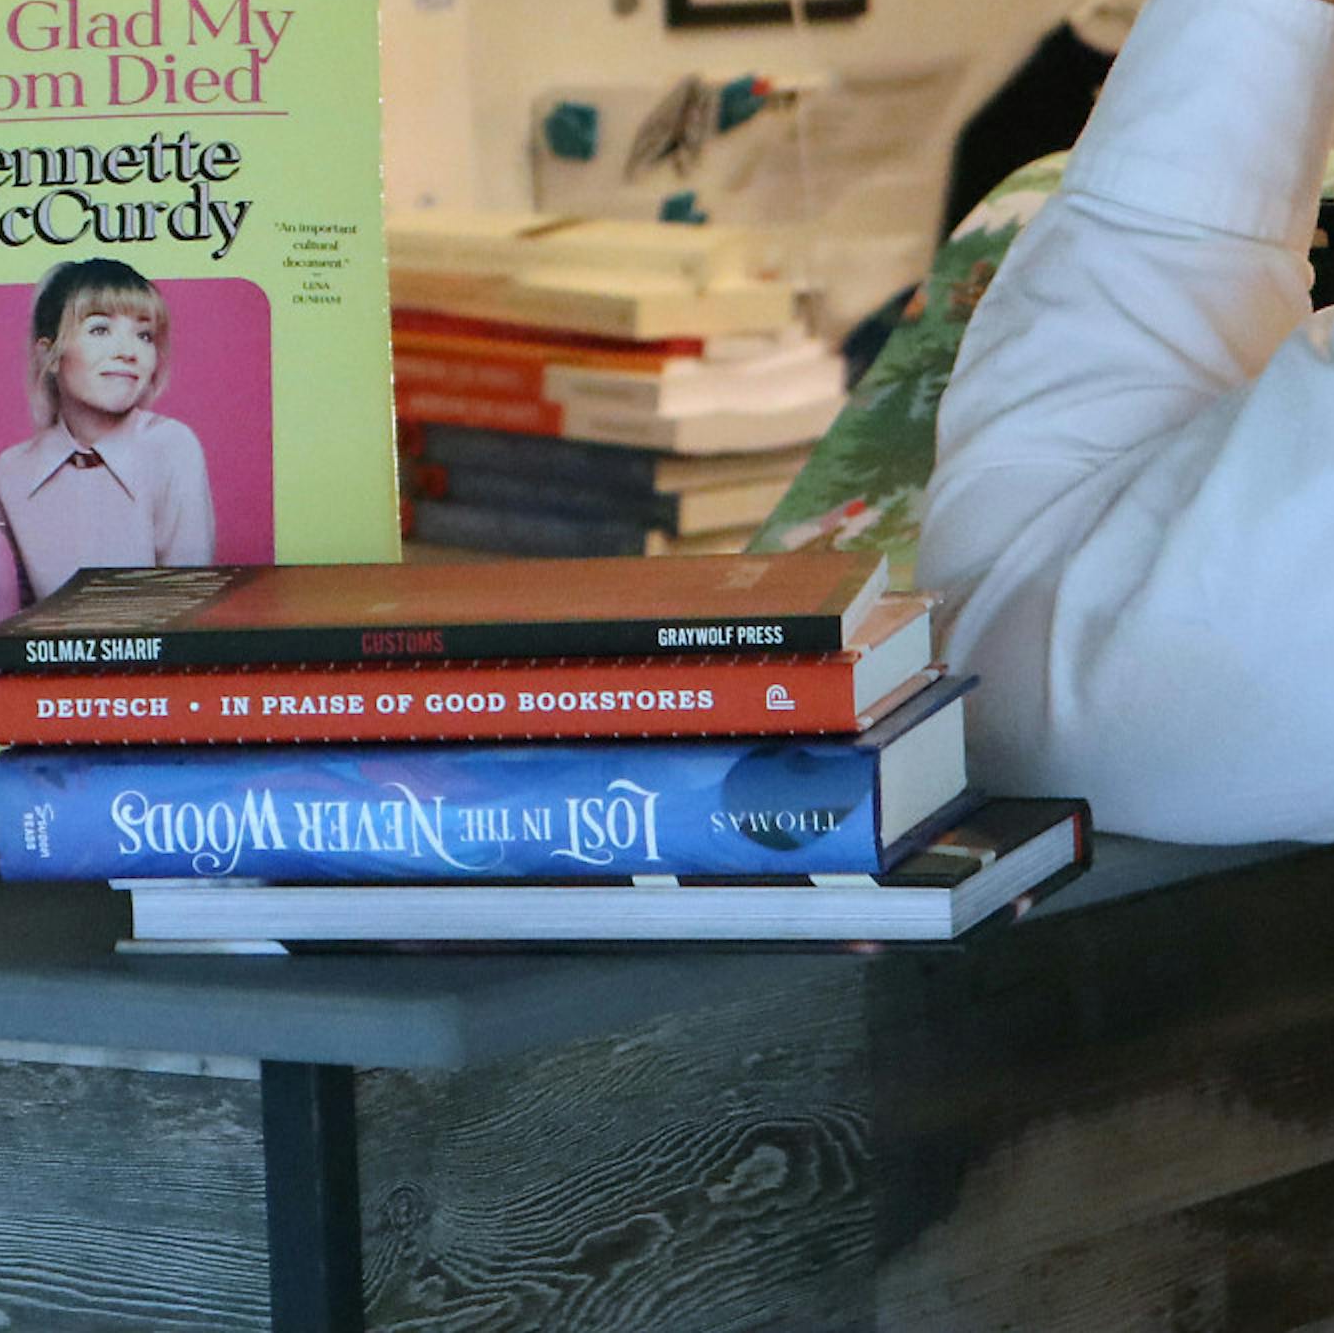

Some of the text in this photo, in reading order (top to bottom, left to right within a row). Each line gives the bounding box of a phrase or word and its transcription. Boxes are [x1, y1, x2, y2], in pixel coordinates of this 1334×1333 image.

[107, 49, 267, 107] Died
[299, 223, 357, 236] important
[361, 630, 445, 656] CUSTOMS
[657, 624, 784, 647] GRAYWOLF PRESS
[25, 637, 164, 664] SOLMAZ SHARIF
[37, 697, 169, 719] DEUTSCH
[220, 688, 715, 716] IN PRAISE OF GOOD BOOKSTORES
[110, 778, 662, 876] LOST IN THE NEVER WOODS
[710, 809, 841, 834] THOMAS
